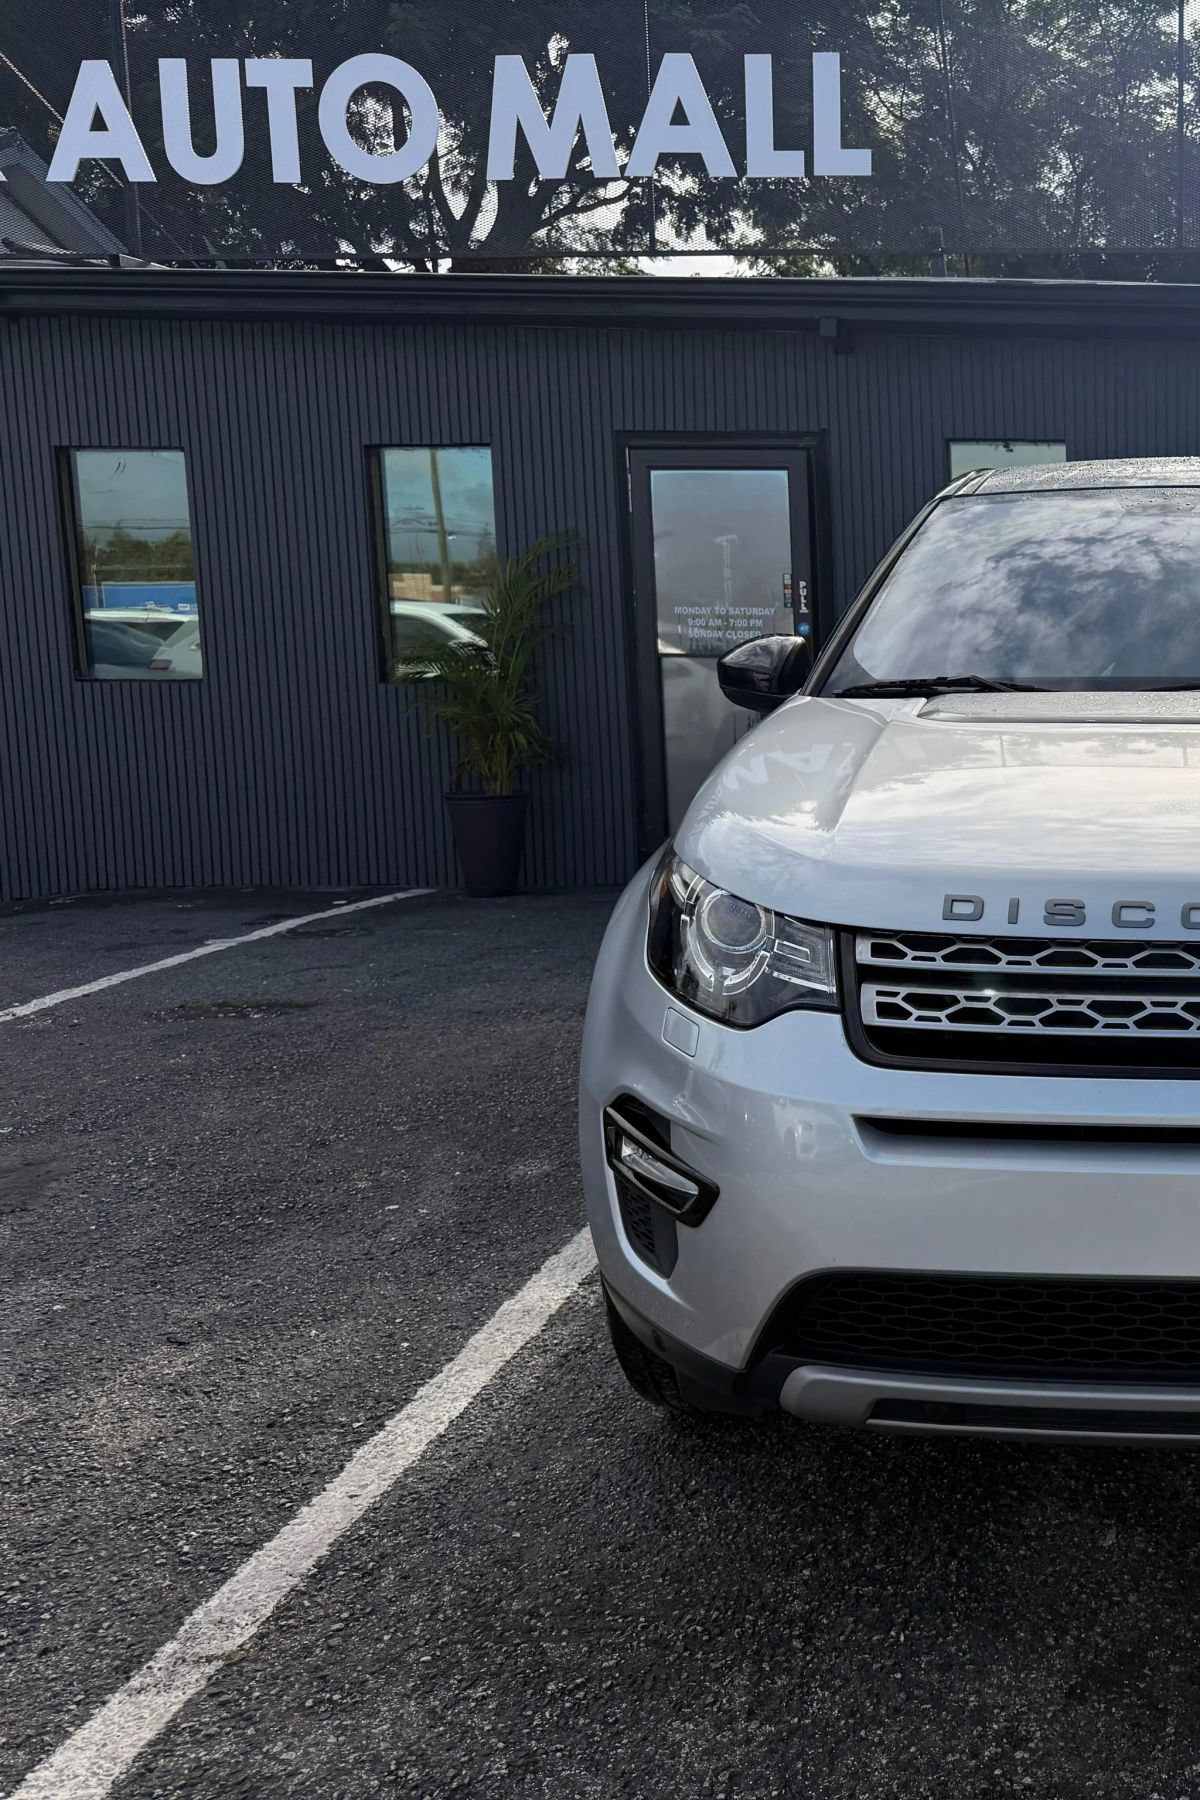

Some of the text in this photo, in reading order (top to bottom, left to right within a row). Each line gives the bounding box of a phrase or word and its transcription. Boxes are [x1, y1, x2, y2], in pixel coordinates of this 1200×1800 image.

[46, 52, 872, 185] AUTO MALL
[674, 606, 775, 616] MONDAY TO SATURDAY
[687, 618, 706, 627] 9:00
[708, 619, 723, 627] AM
[729, 619, 748, 627] 7:00
[750, 619, 763, 627] PM
[688, 630, 723, 638] SUNDAY
